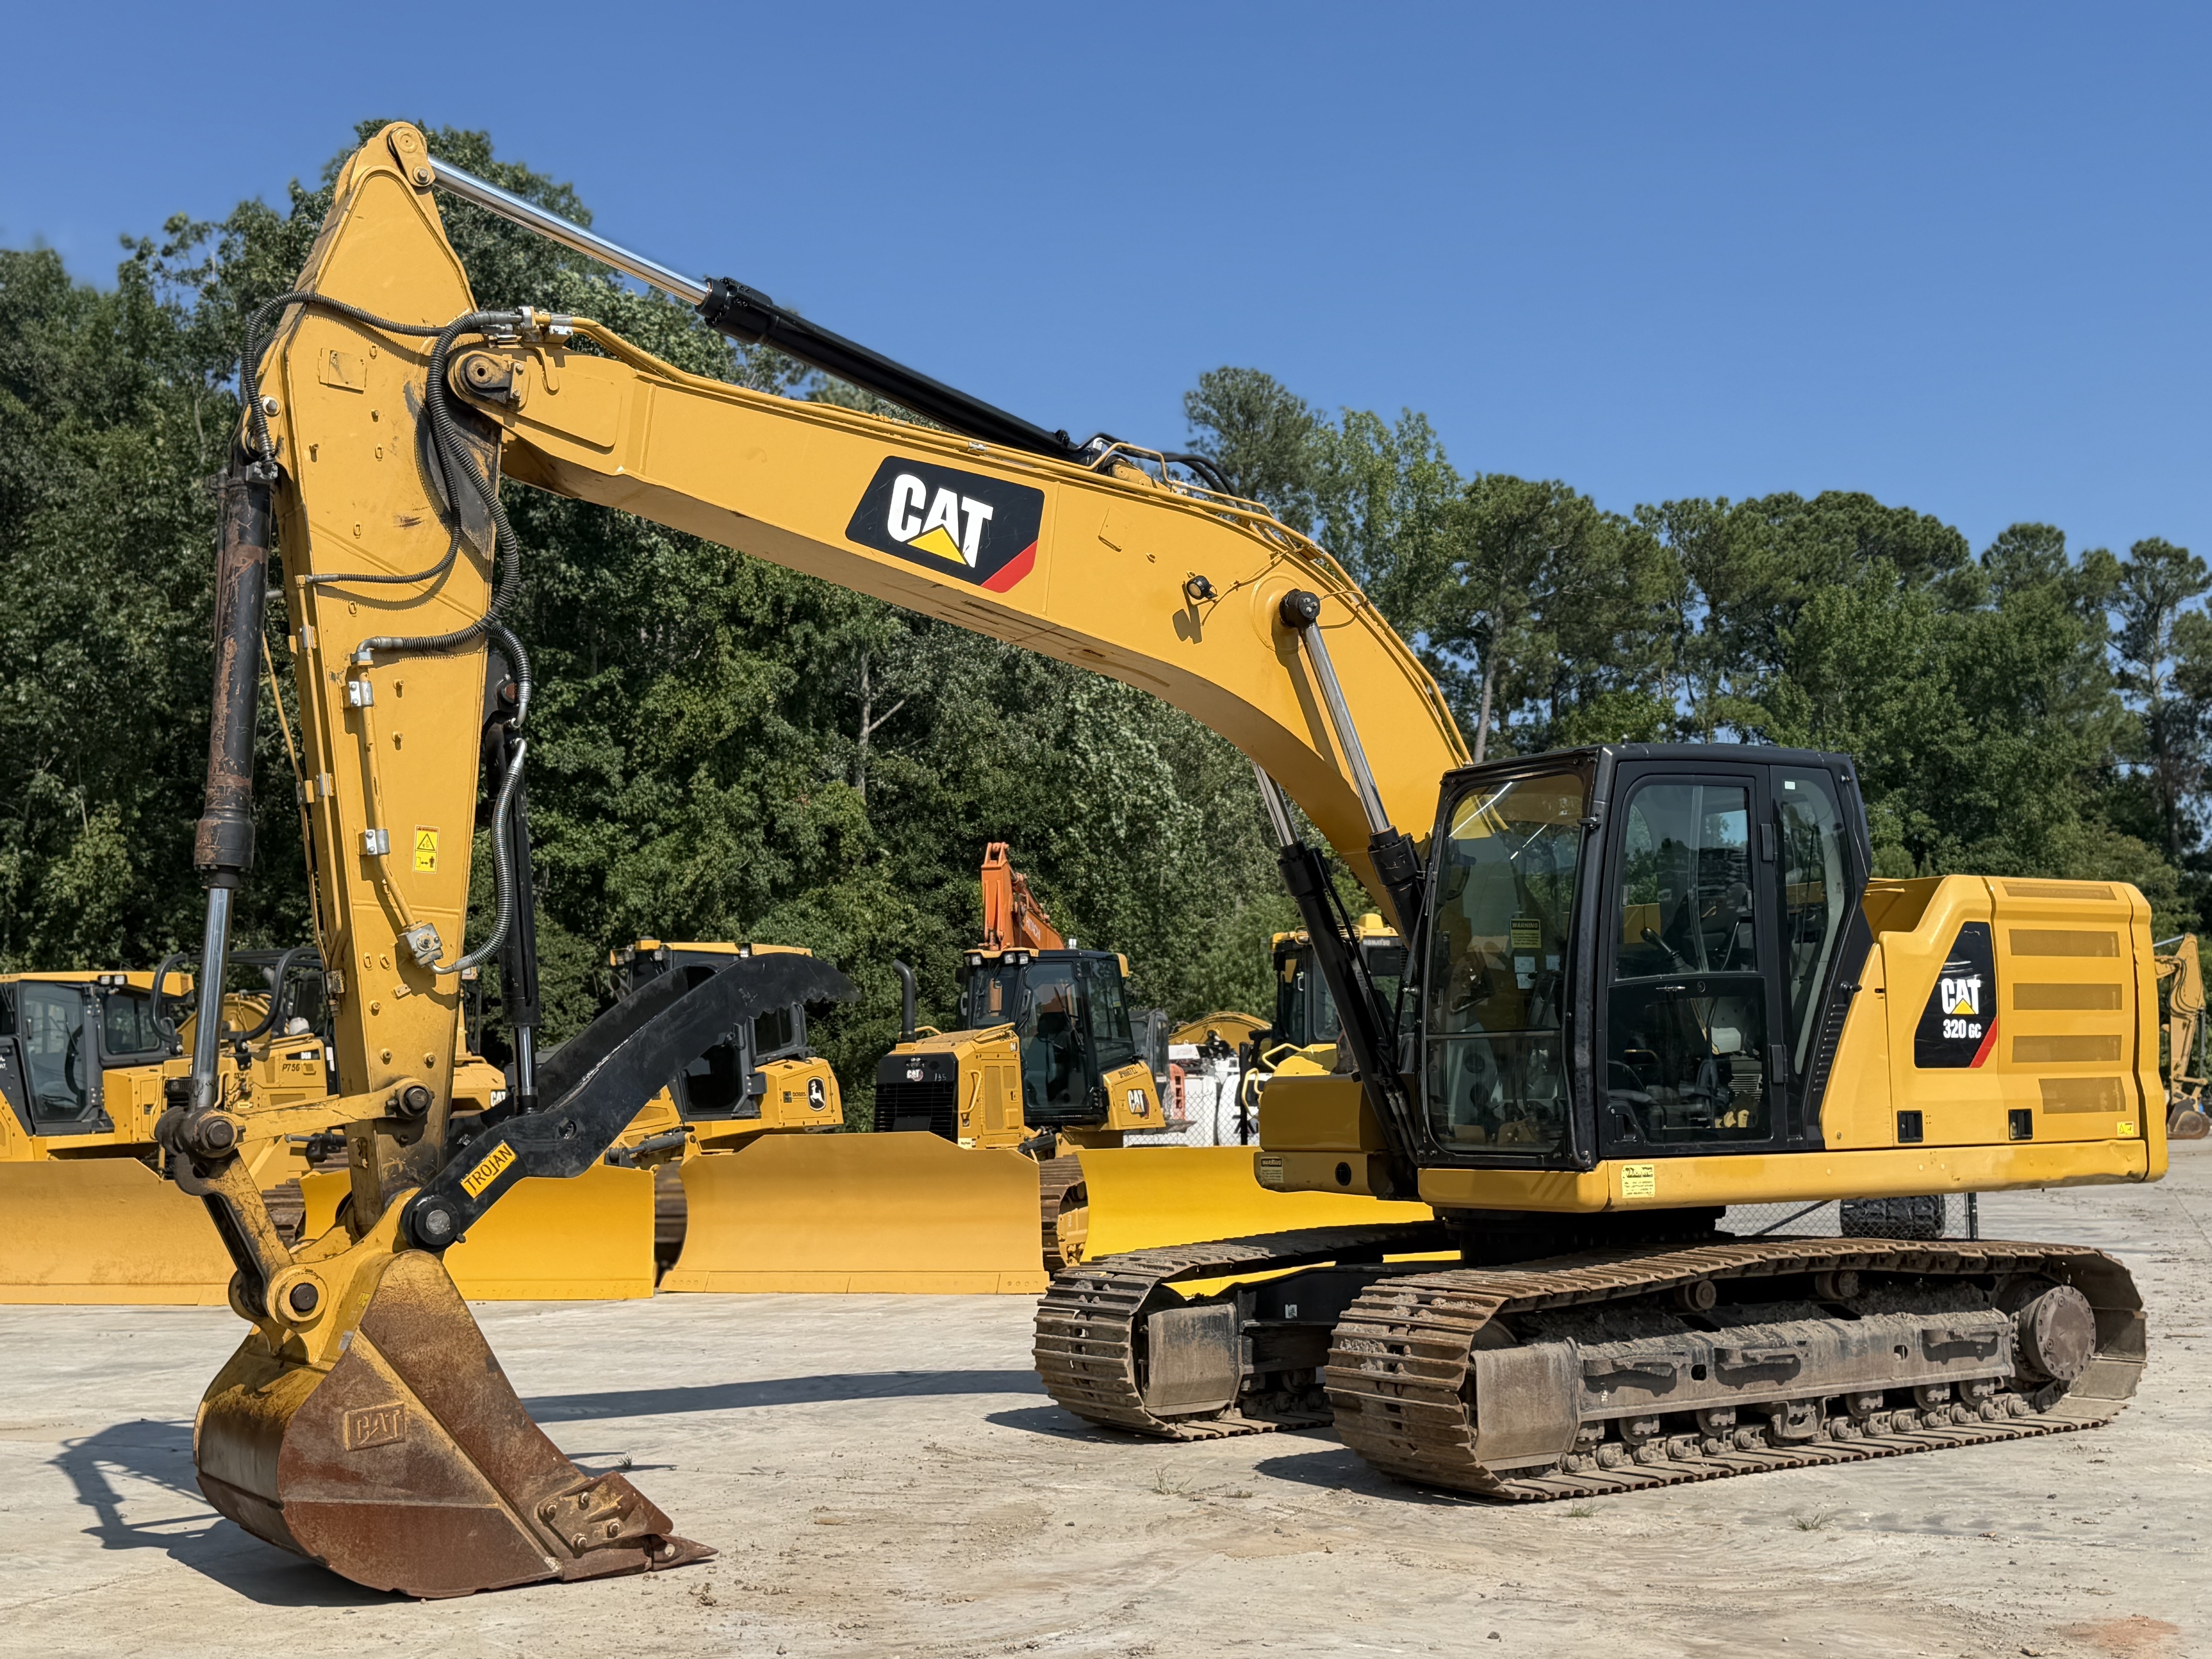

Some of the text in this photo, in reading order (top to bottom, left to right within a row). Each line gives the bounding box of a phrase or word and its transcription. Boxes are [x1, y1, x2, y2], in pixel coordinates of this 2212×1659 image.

[887, 474, 994, 568] CAT
[1941, 978, 1981, 1015] CAT
[1943, 1019, 1982, 1039] 320 GC
[907, 1069, 920, 1079] CAT
[1127, 1089, 1145, 1113] CAT
[464, 1145, 512, 1193] TROJAN
[357, 1410, 400, 1444] CAT
